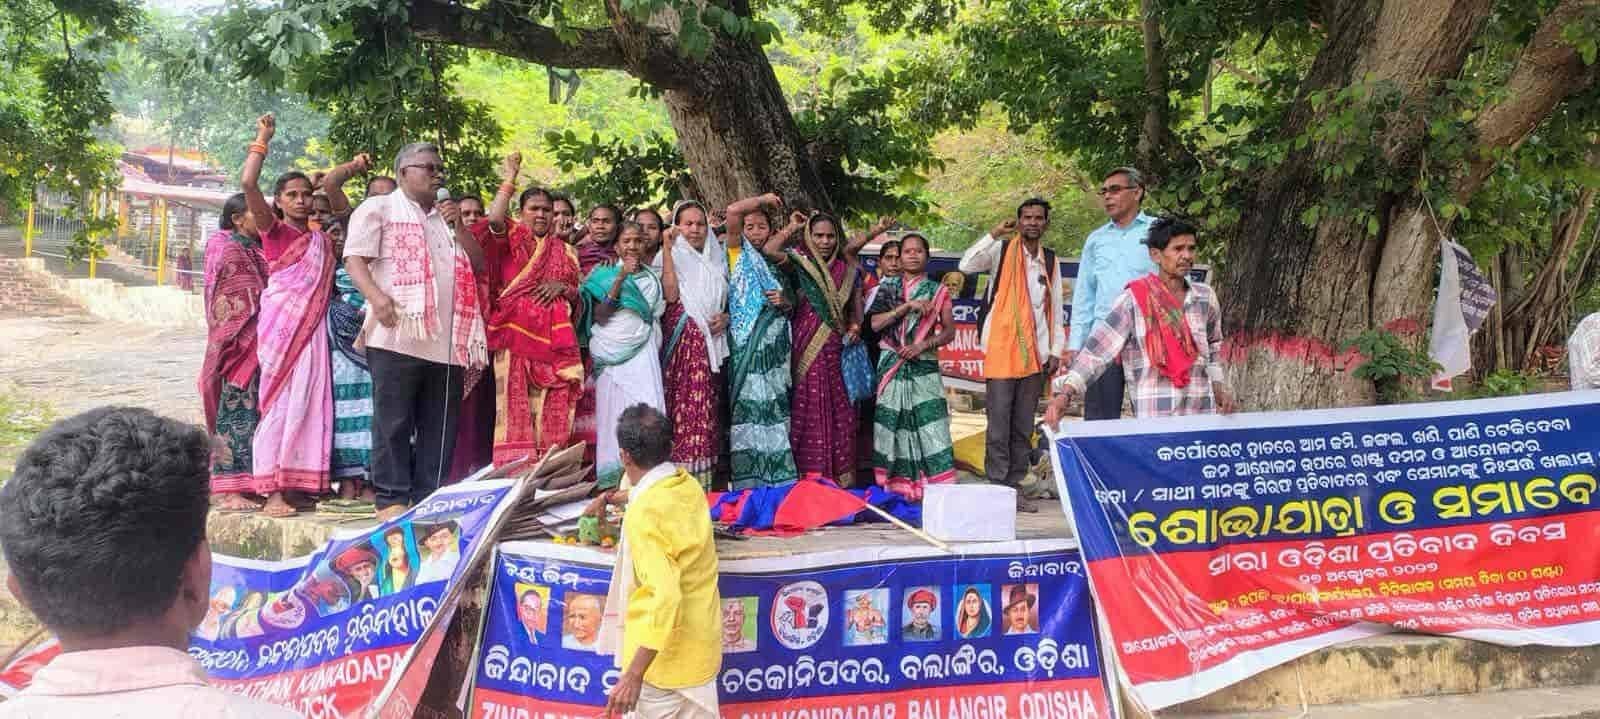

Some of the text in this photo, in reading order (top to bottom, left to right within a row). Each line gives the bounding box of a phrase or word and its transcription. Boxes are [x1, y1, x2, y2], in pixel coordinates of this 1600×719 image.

[1247, 440, 1296, 458] ହାତରେ
[1299, 437, 1326, 452] ଆମ
[1447, 422, 1480, 441] ପାଣି
[1485, 418, 1571, 437] ଟେକିଦେବା
[1202, 464, 1230, 478] ଜନ
[1234, 459, 1296, 476] ଆନ୍ଦୋଳନ
[1300, 454, 1346, 471] ଉପରେ
[1388, 449, 1426, 463] ଦମନ
[1432, 447, 1445, 460] ଓ
[1450, 439, 1541, 458] ଆନ୍ଦୋଳନର
[1152, 486, 1195, 501] ସାଥୀ
[1201, 482, 1250, 500] ମାନଙ୍କୁ
[1254, 477, 1292, 495] ଗିରଫ
[1296, 472, 1368, 494] ପ୍ରତିବାଦରେ
[1373, 470, 1402, 484] ଏବଂ
[1407, 463, 1480, 480] ସେମାନଙ୍କୁ
[1128, 496, 1363, 547] ଶୋଭାଯାତ୍ରା
[1379, 491, 1416, 524] ଓ
[1208, 522, 1567, 576] ସାରା ଓଡ଼ିଶା ପ୍ରତିବାଦ ଦିବସ
[484, 644, 591, 694] ଜିନ୍ଦାବାଦ
[1014, 637, 1089, 678] ଓଡ଼ିଶା
[1019, 688, 1099, 719] ODISHA
